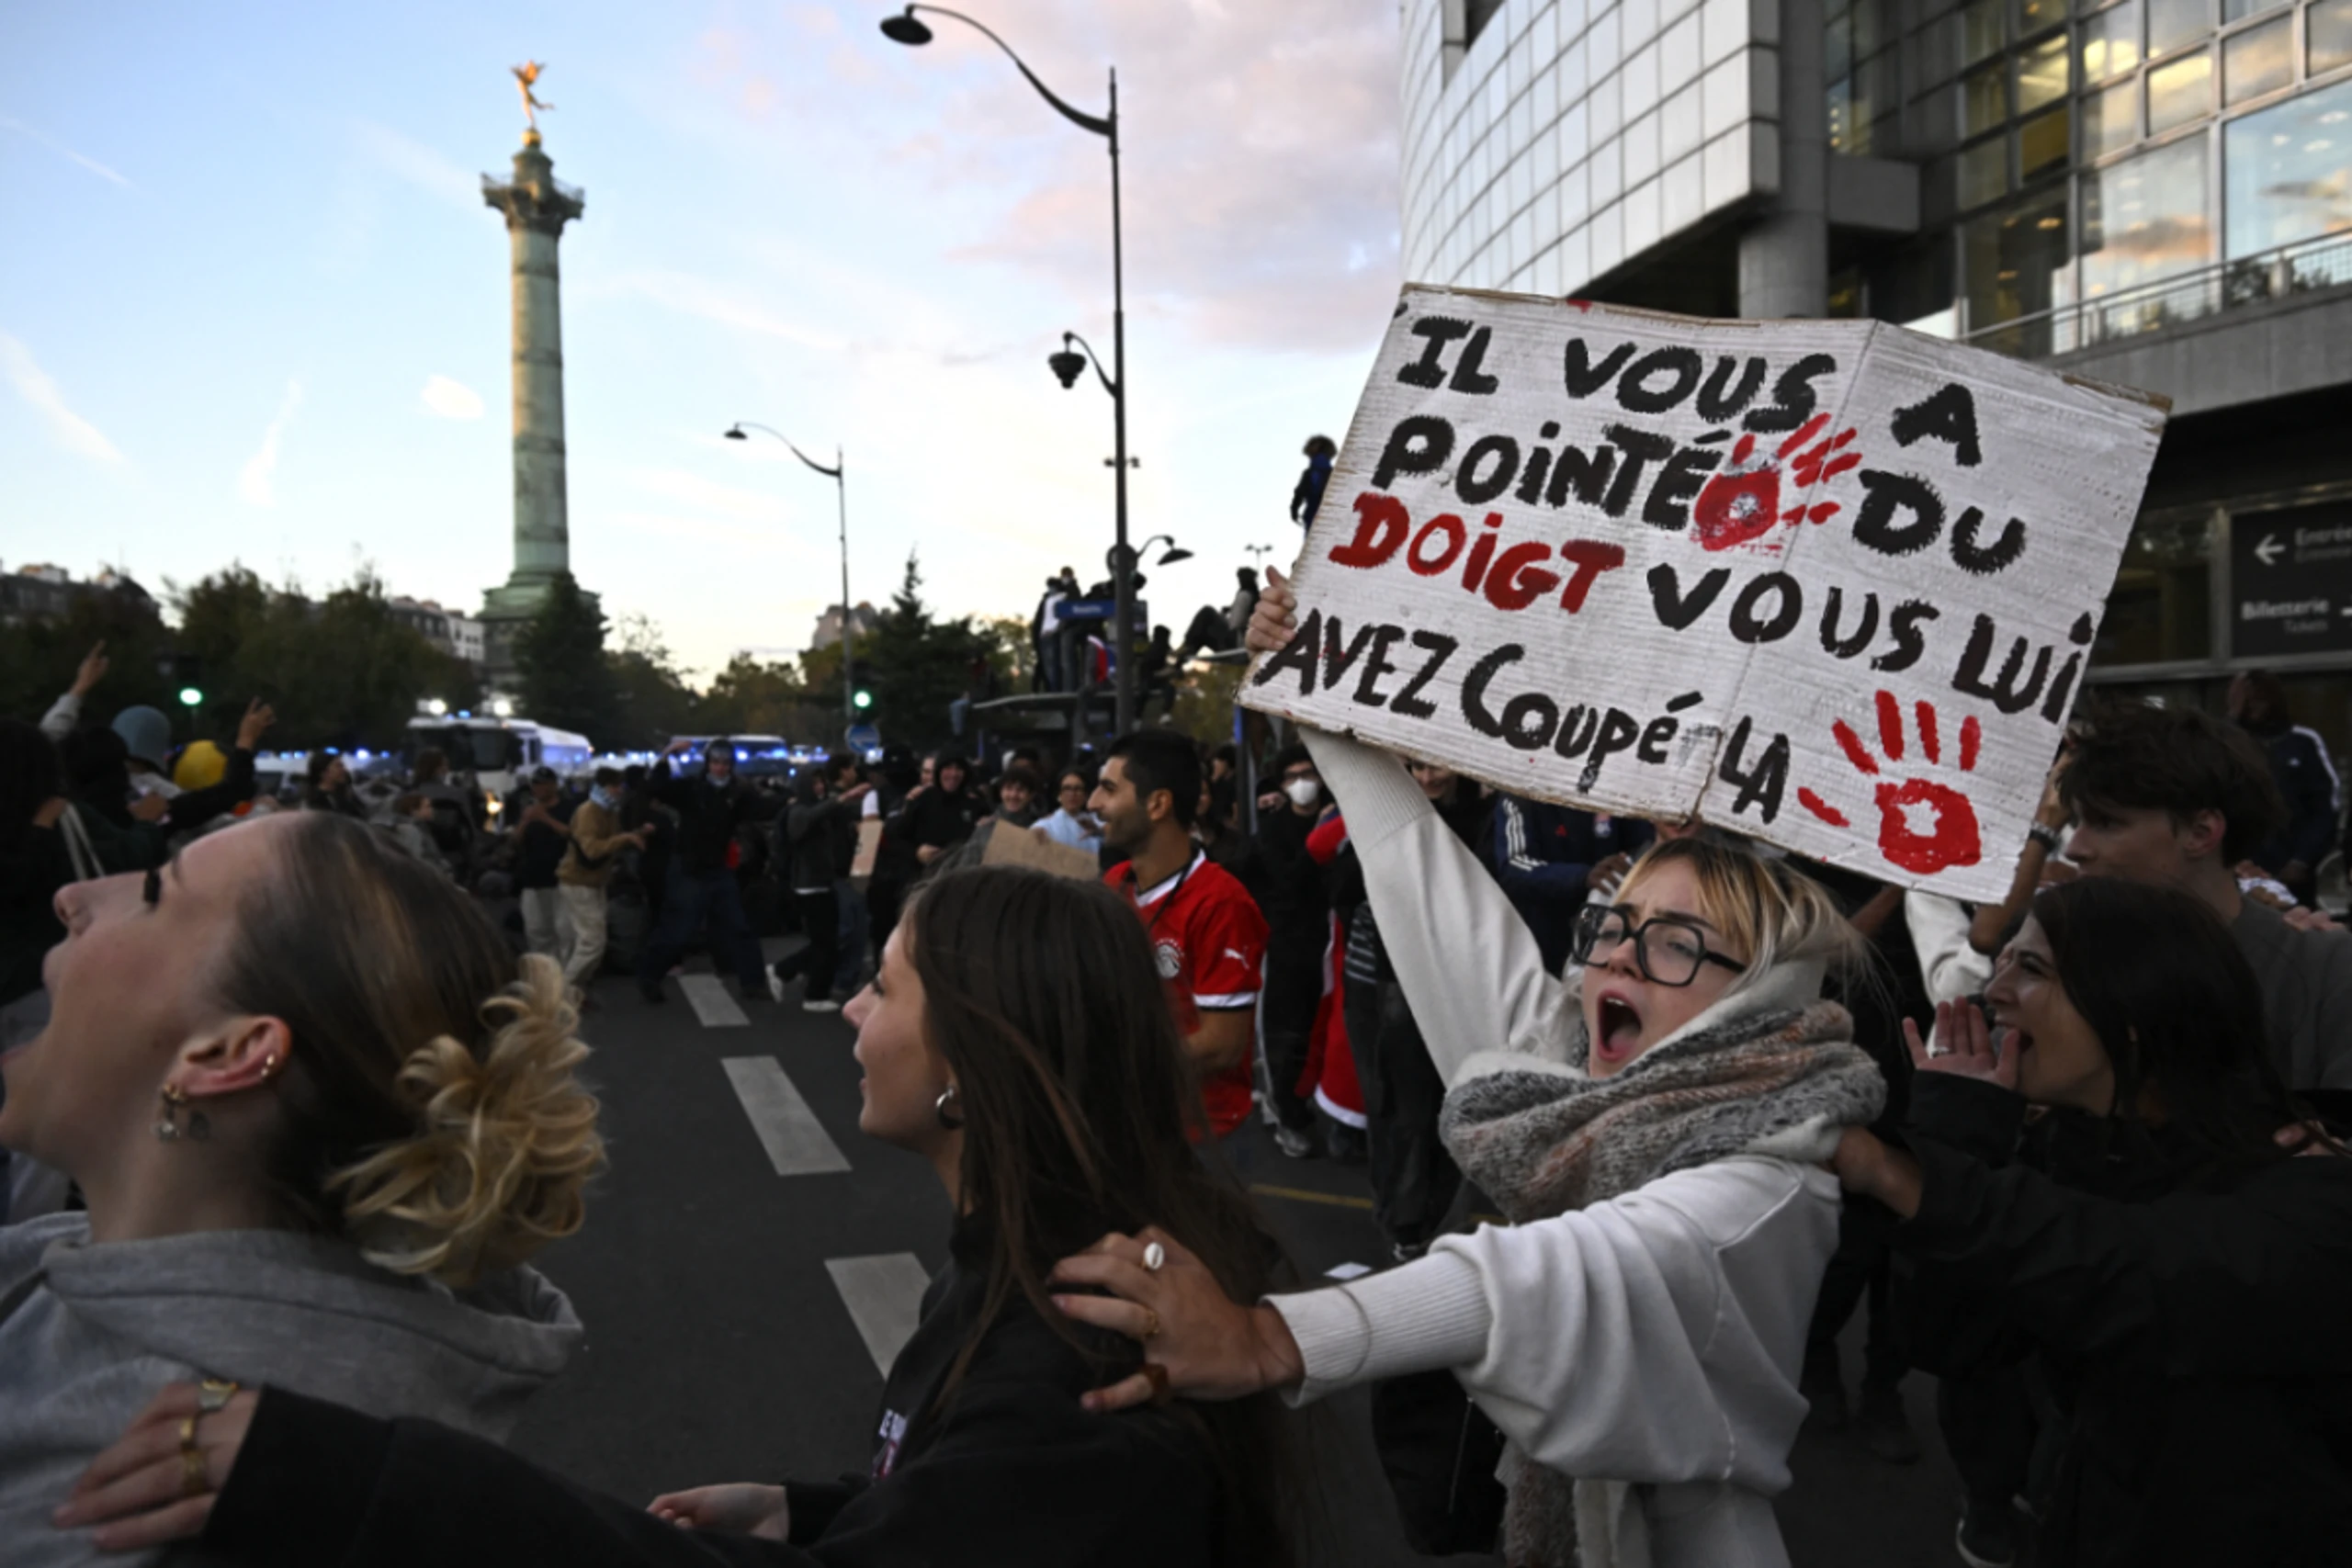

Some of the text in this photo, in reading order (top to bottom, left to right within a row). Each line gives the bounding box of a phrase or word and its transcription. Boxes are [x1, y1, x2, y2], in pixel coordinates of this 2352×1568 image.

[1396, 315, 1982, 467] IL VOUS A
[1852, 468, 2026, 576] DU
[1646, 563, 1940, 671] VOUS
[1252, 607, 1459, 719] AVEZ
[1719, 716, 1790, 824] LA
